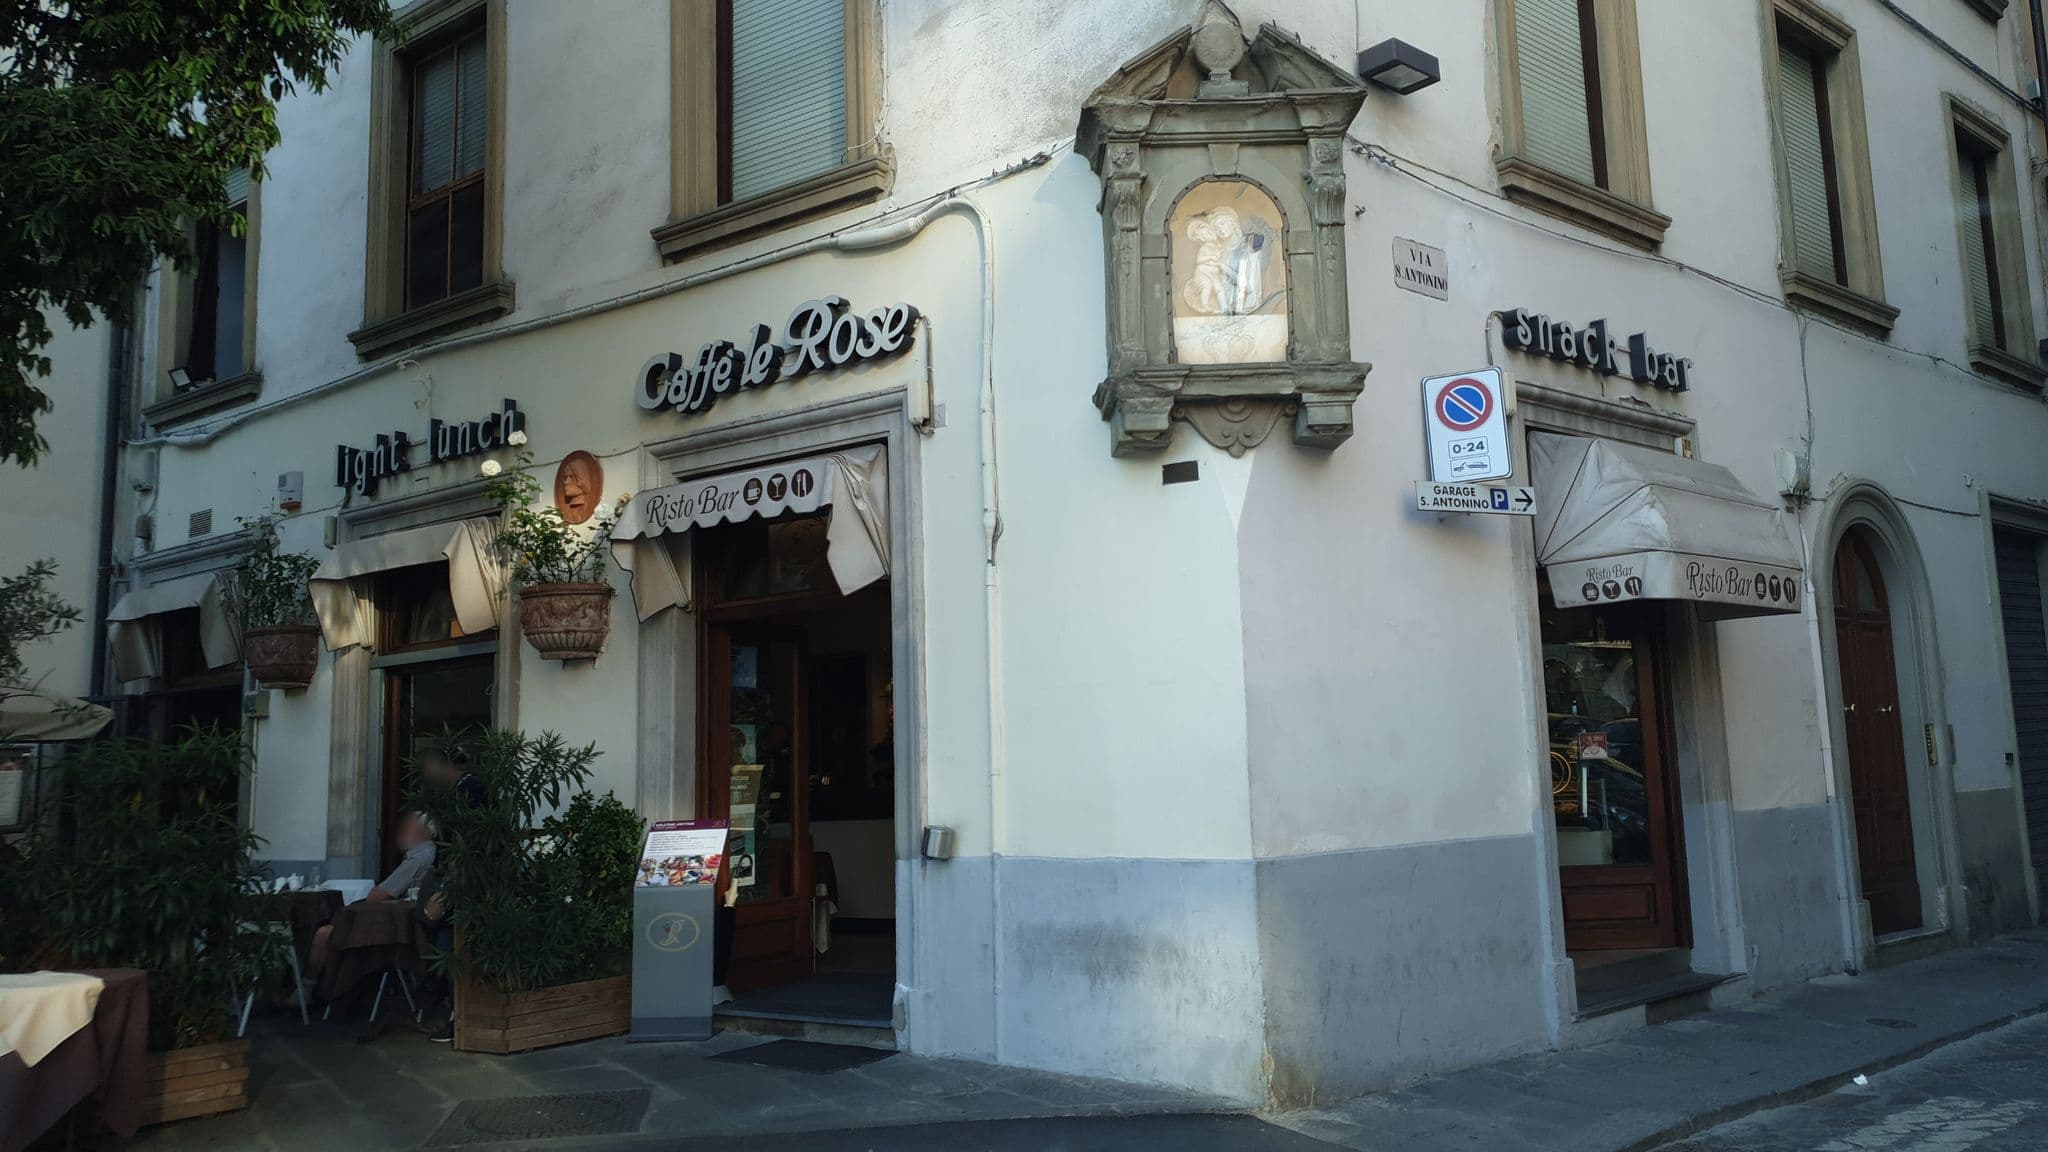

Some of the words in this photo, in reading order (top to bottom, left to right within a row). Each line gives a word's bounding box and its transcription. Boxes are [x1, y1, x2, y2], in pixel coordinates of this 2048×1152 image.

[1409, 248, 1432, 267] VIA
[740, 324, 784, 388] le
[781, 295, 917, 378] Rose
[1503, 307, 1619, 373] snack
[1630, 331, 1692, 392] bar
[337, 431, 410, 496] light
[427, 398, 525, 462] lunch
[1452, 440, 1486, 454] 0-24
[1420, 496, 1430, 507] S.
[1432, 497, 1489, 509] ANTONINO
[1433, 485, 1476, 496] GARAGE
[646, 494, 694, 527] Risto
[699, 485, 740, 514] Bar
[1586, 567, 1611, 584] Risto
[1611, 564, 1634, 578] Bar
[1686, 561, 1723, 598] Risto
[1725, 566, 1752, 597] Bar
